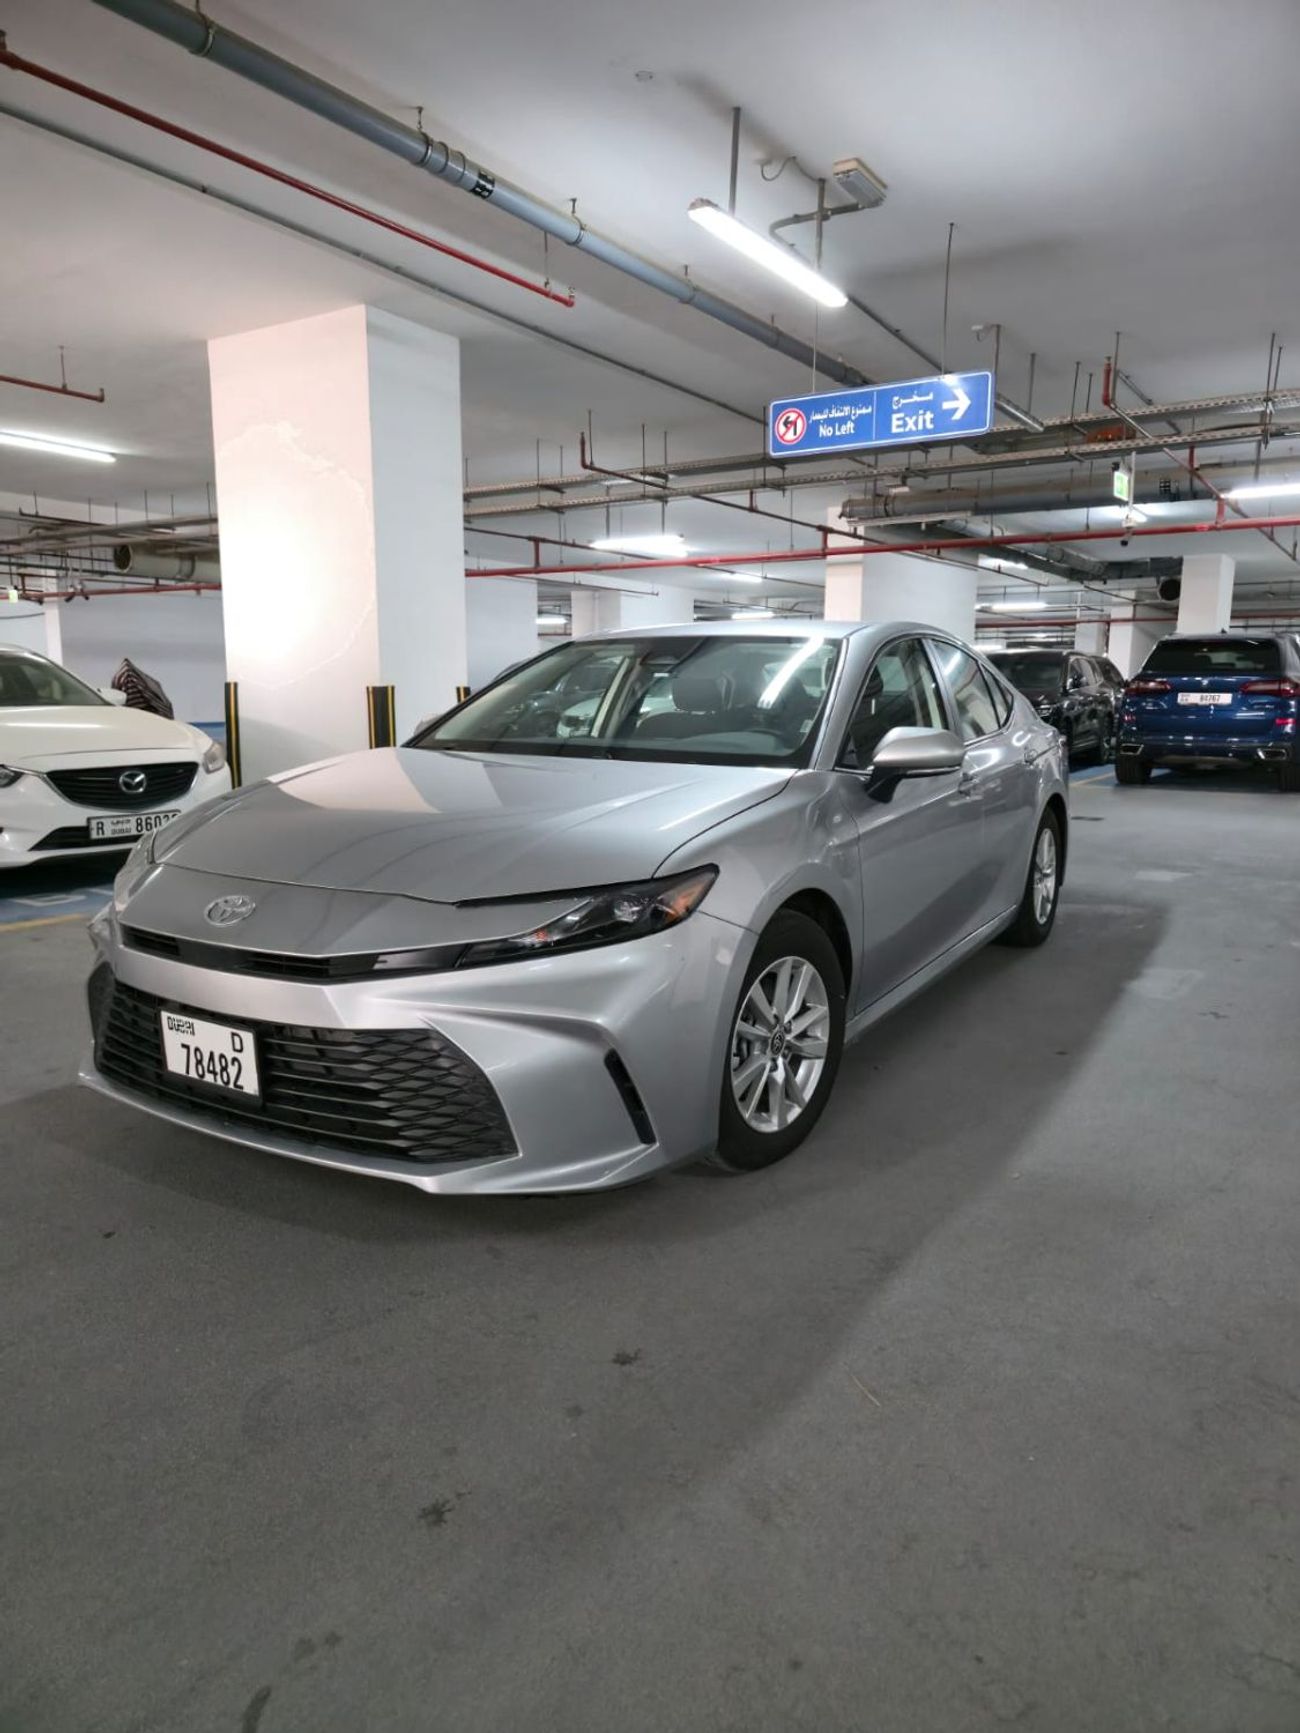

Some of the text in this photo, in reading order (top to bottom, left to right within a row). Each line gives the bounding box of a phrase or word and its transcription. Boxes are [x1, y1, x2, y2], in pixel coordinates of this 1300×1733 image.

[892, 390, 934, 410] مخرج
[819, 420, 855, 438] No Left
[892, 410, 934, 433] Exit
[96, 821, 105, 836] R
[230, 1031, 244, 1053] D
[181, 1043, 244, 1090] 78482
